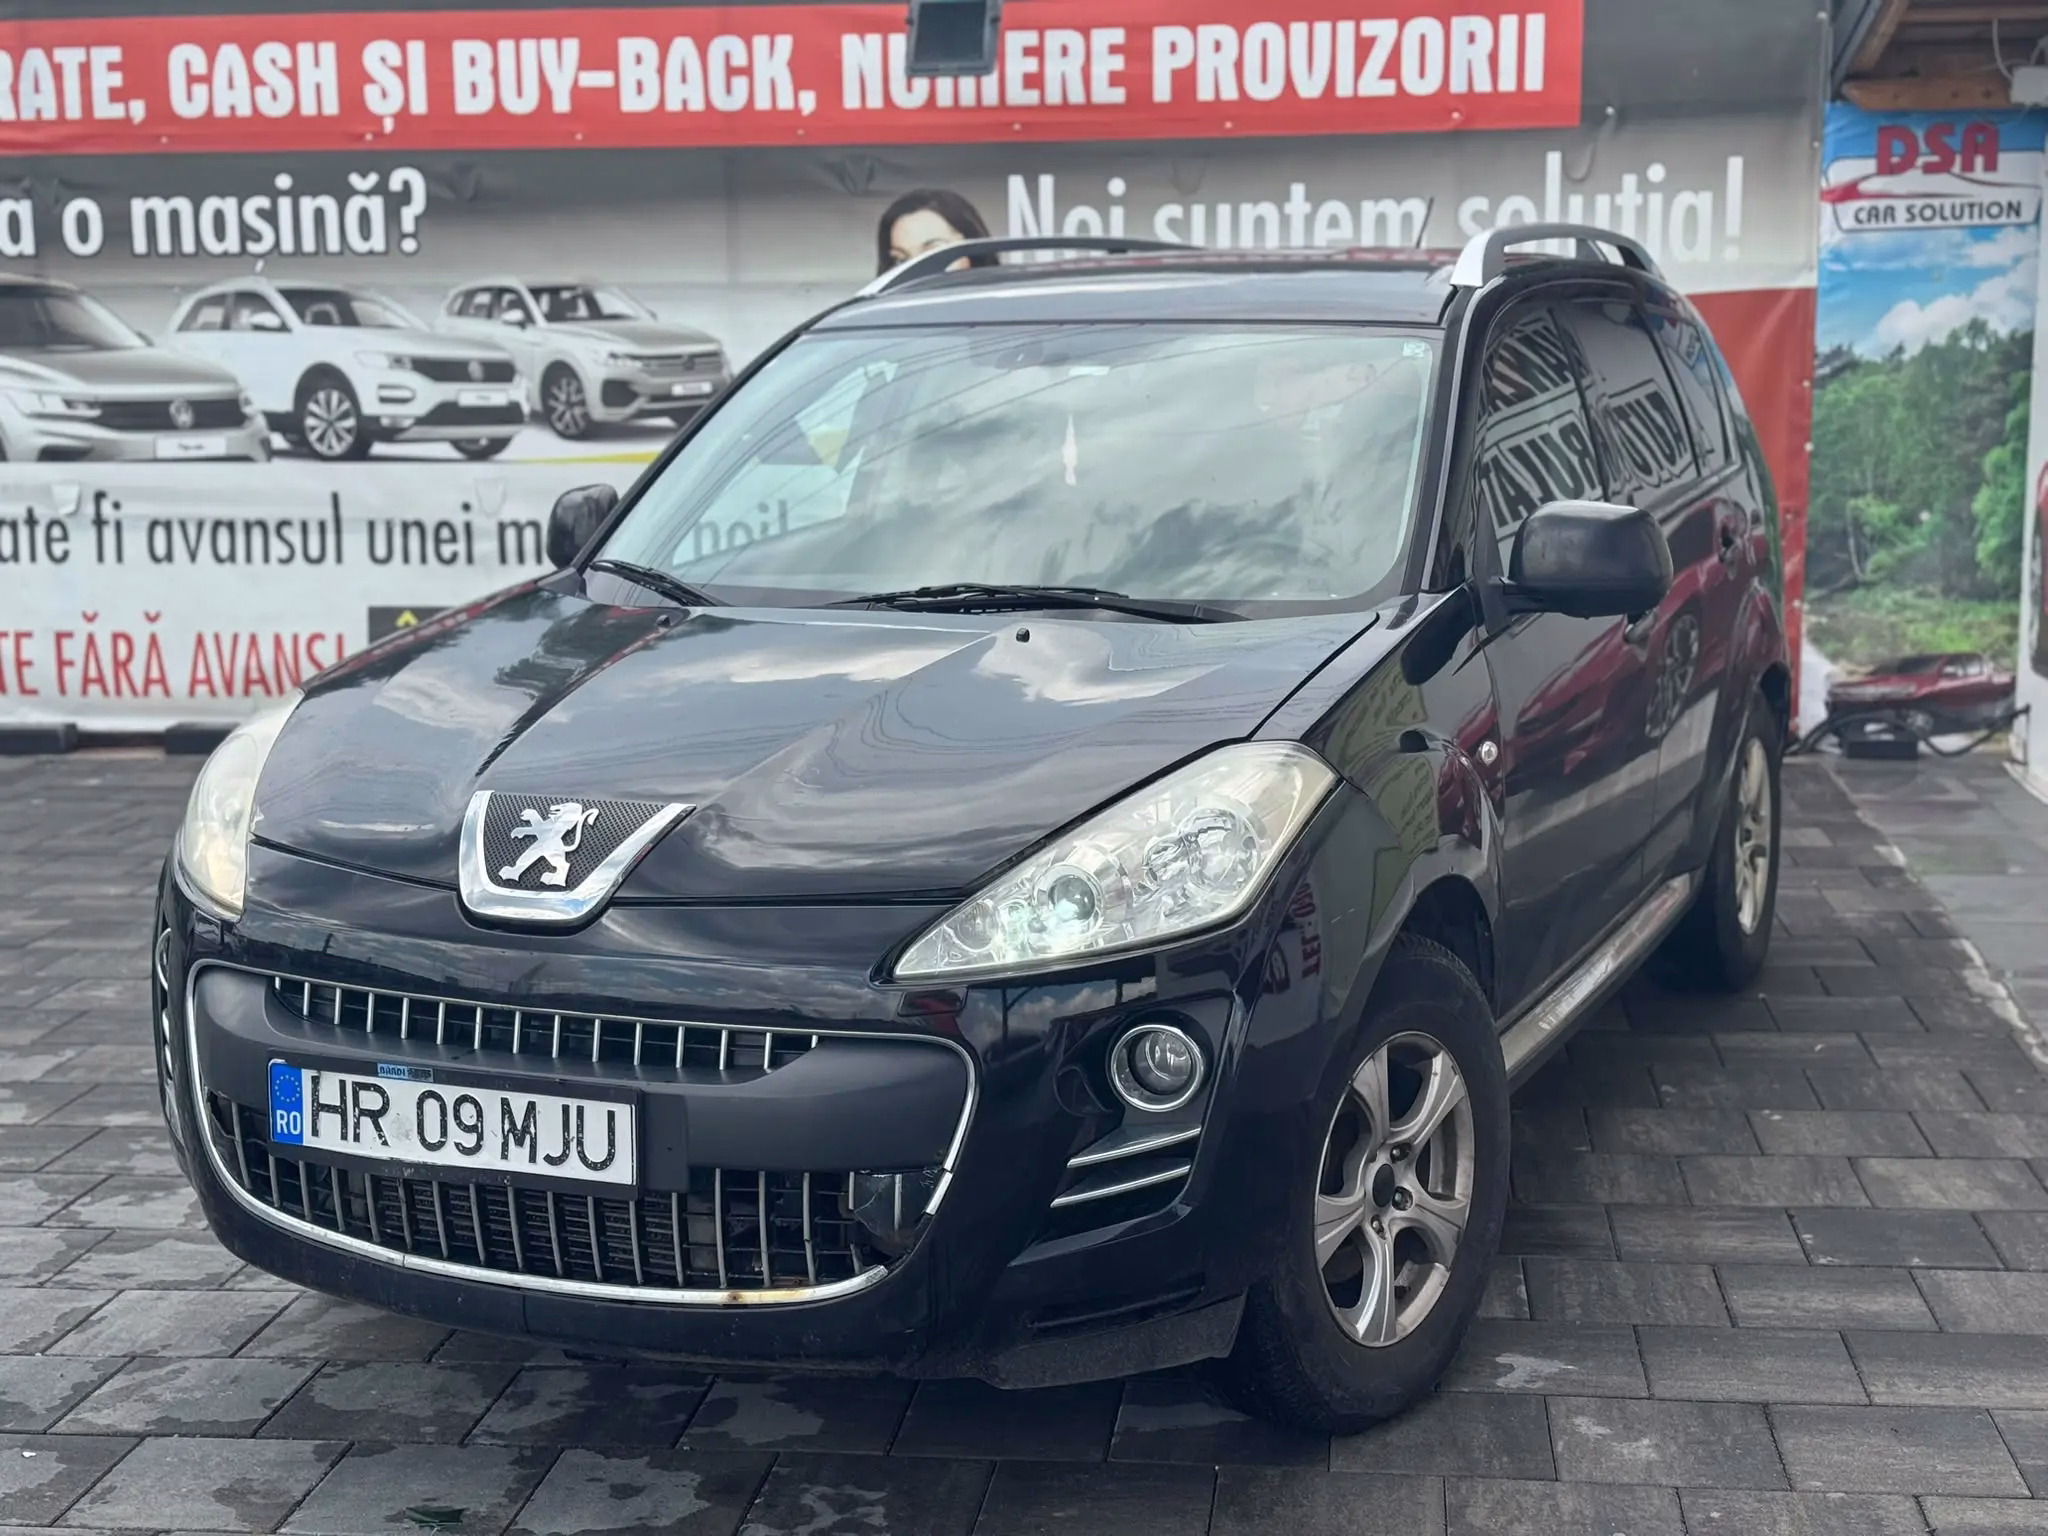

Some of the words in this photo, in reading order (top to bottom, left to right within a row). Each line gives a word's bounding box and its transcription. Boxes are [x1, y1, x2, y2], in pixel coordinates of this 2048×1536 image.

[168, 41, 340, 119] CASH
[452, 34, 816, 118] BUY-BACK,
[1152, 13, 1547, 103] PROVIZORII
[1877, 121, 1999, 177] DSA
[61, 197, 104, 257] o
[130, 166, 428, 273] mașină?
[1854, 204, 1897, 225] CAR
[1905, 200, 2023, 222] SOLUTION
[91, 490, 124, 564] fi
[148, 491, 342, 564] avansul
[367, 502, 474, 565] unei
[55, 610, 171, 698] FĂRĂ
[276, 1109, 301, 1136] RO
[310, 1072, 392, 1148] HR
[416, 1089, 485, 1157] 09
[500, 1096, 617, 1172] MJU
